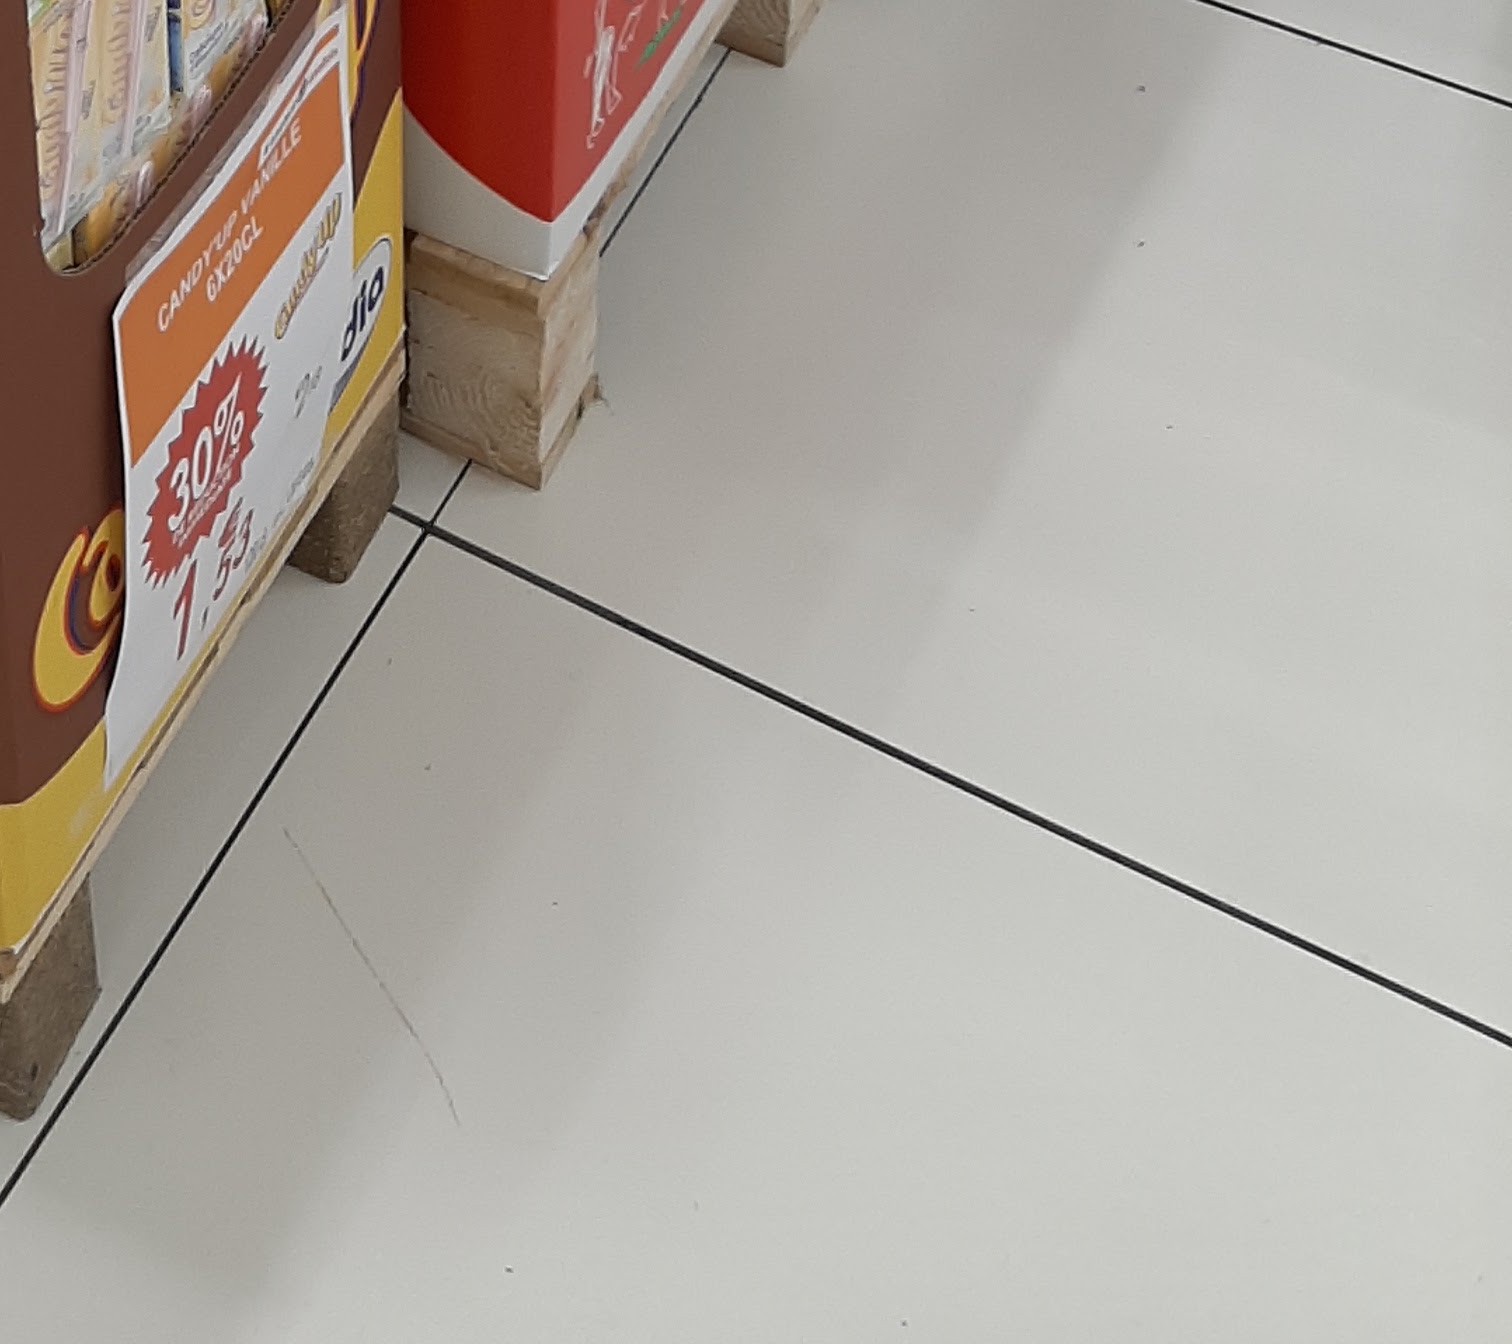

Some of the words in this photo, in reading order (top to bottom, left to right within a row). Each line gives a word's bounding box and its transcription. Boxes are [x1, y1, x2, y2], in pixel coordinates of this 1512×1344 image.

[158, 210, 237, 333] CANDY'UP
[240, 116, 301, 215] VANILLE
[206, 216, 264, 302] 6X20CL
[340, 260, 386, 363] dia
[168, 372, 245, 532] 30%
